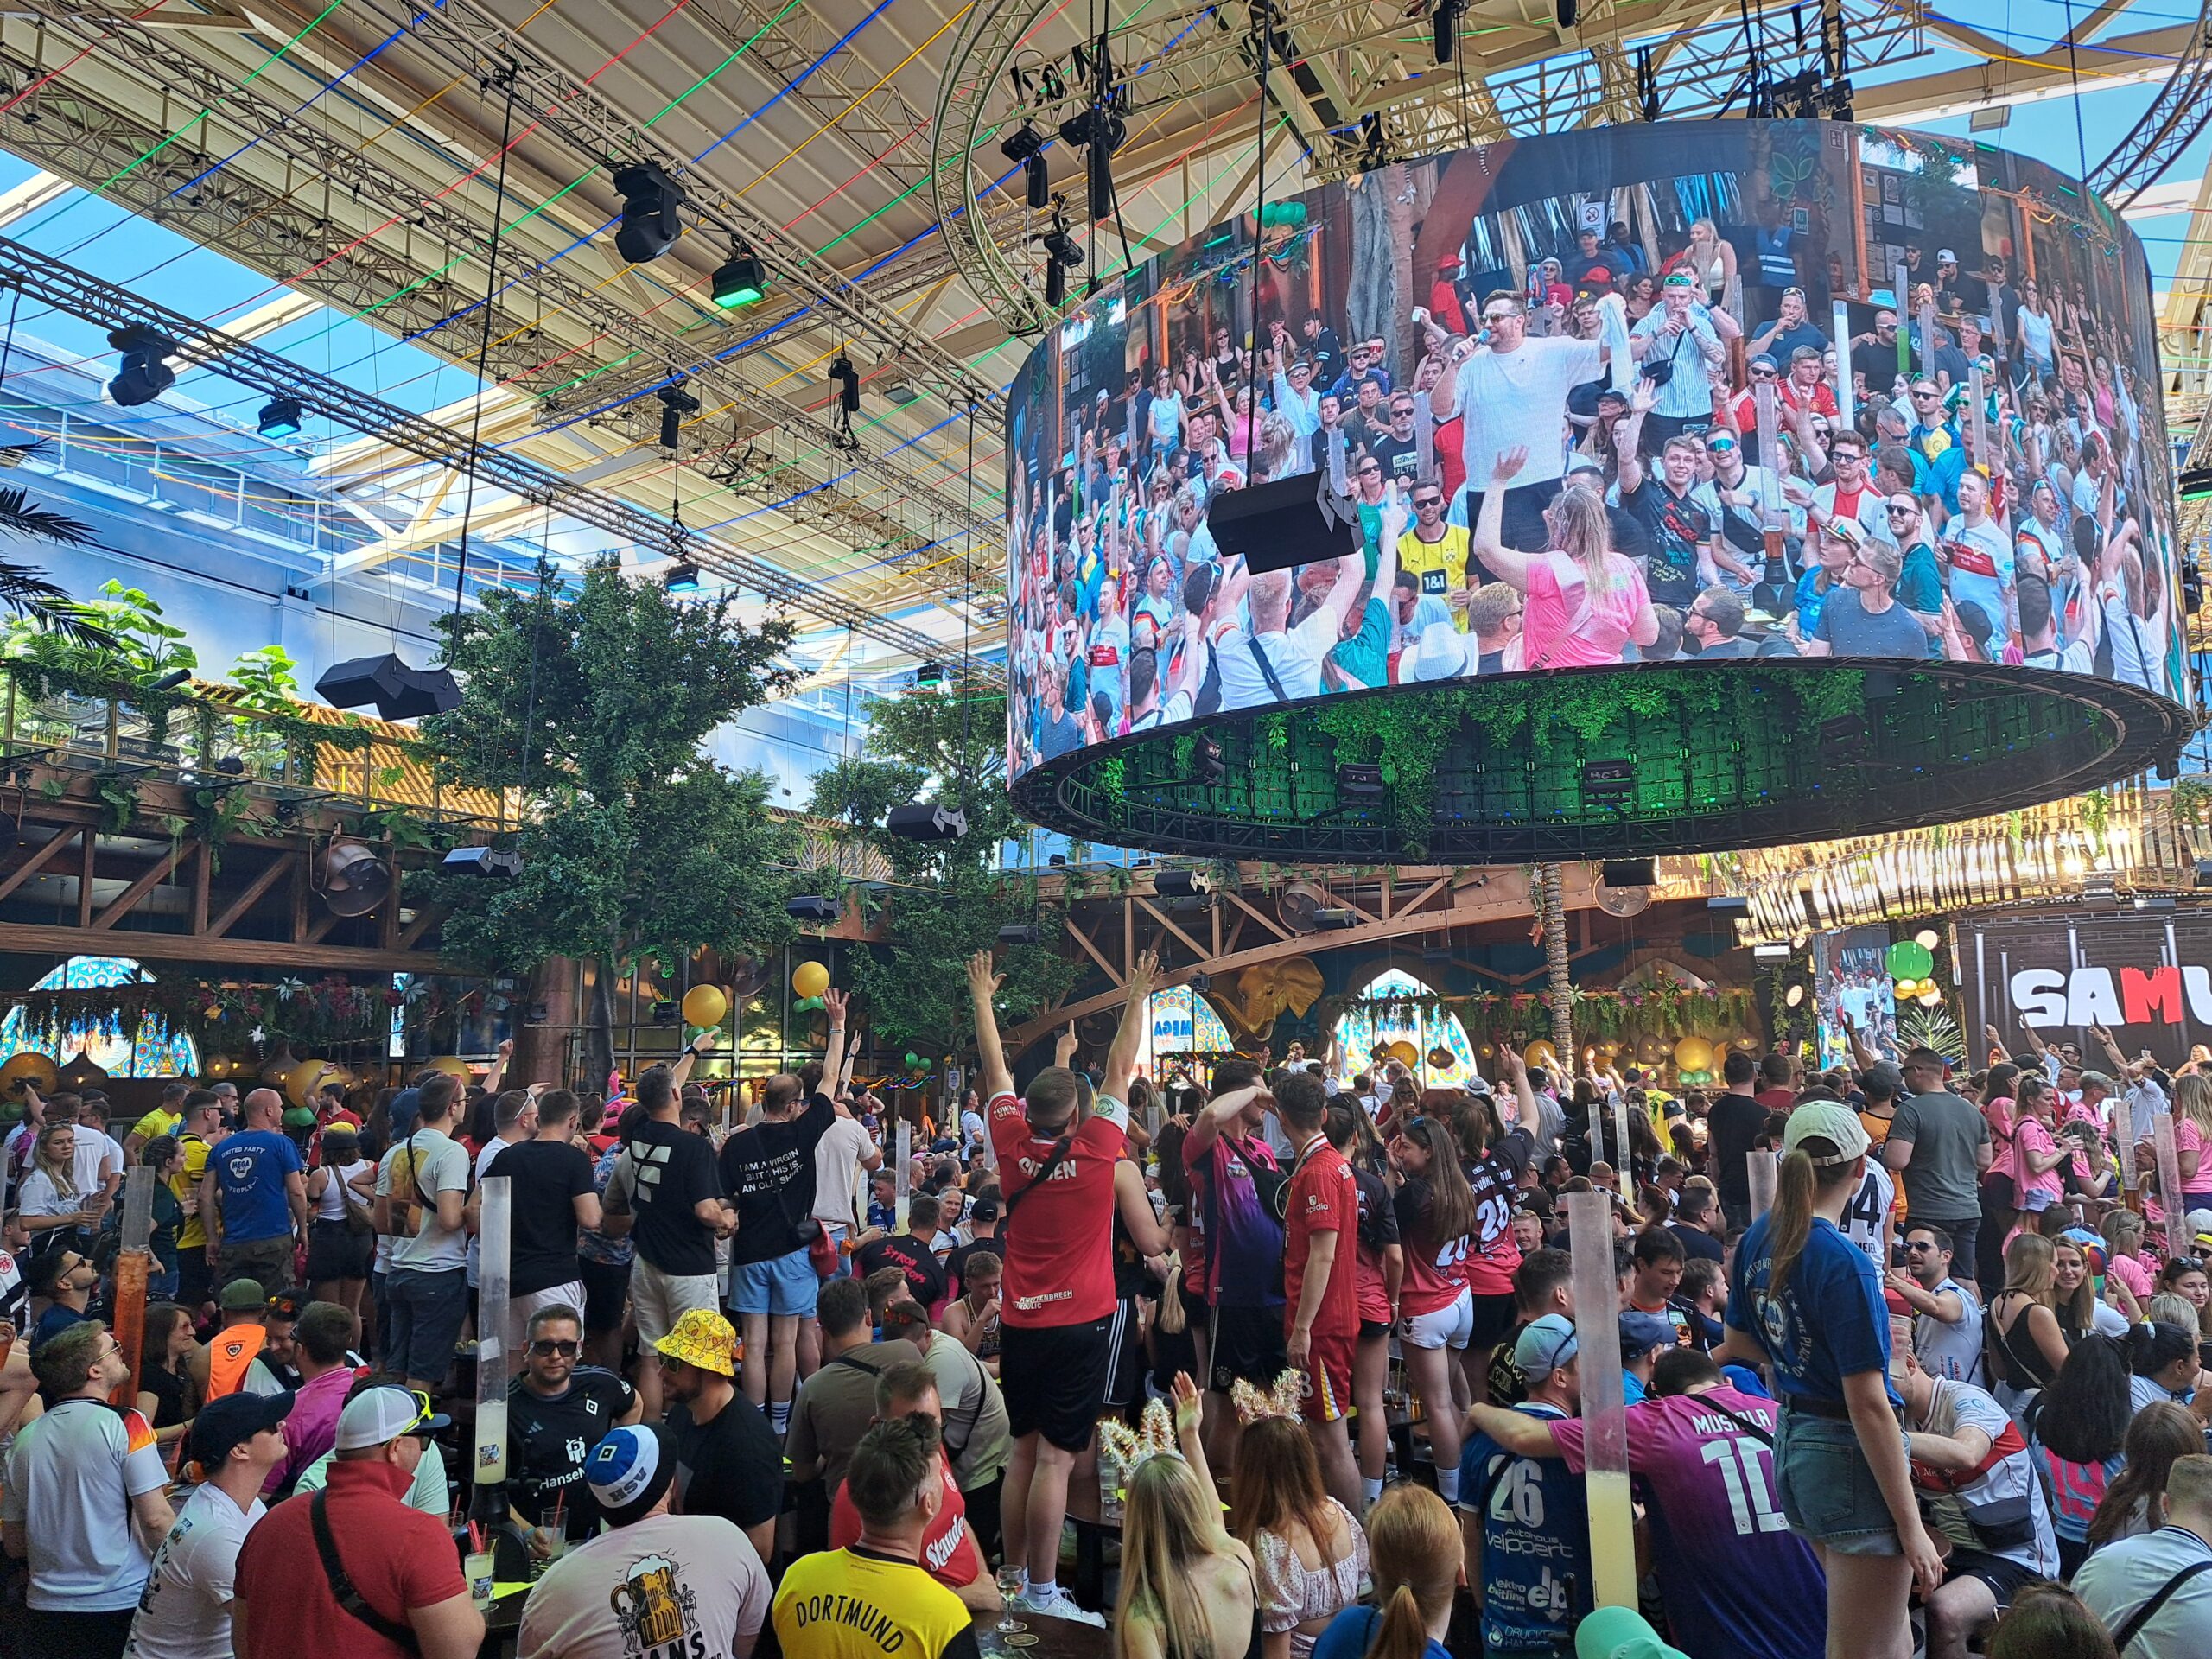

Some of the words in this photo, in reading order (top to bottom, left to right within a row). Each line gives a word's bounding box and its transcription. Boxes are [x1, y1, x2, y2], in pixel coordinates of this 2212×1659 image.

[1424, 575, 1445, 590] 1&1
[221, 1147, 242, 1158] UNITED
[744, 1162, 759, 1172] AM
[769, 1147, 799, 1167] VIRGIN
[746, 1172, 764, 1182] BUT
[766, 1165, 788, 1177] HIS
[1018, 1157, 1077, 1181] SIEEN
[742, 1183, 756, 1193] AN
[608, 1466, 647, 1502] HSV
[1488, 1454, 1544, 1528] 26
[796, 1594, 904, 1654] DORTMUND
